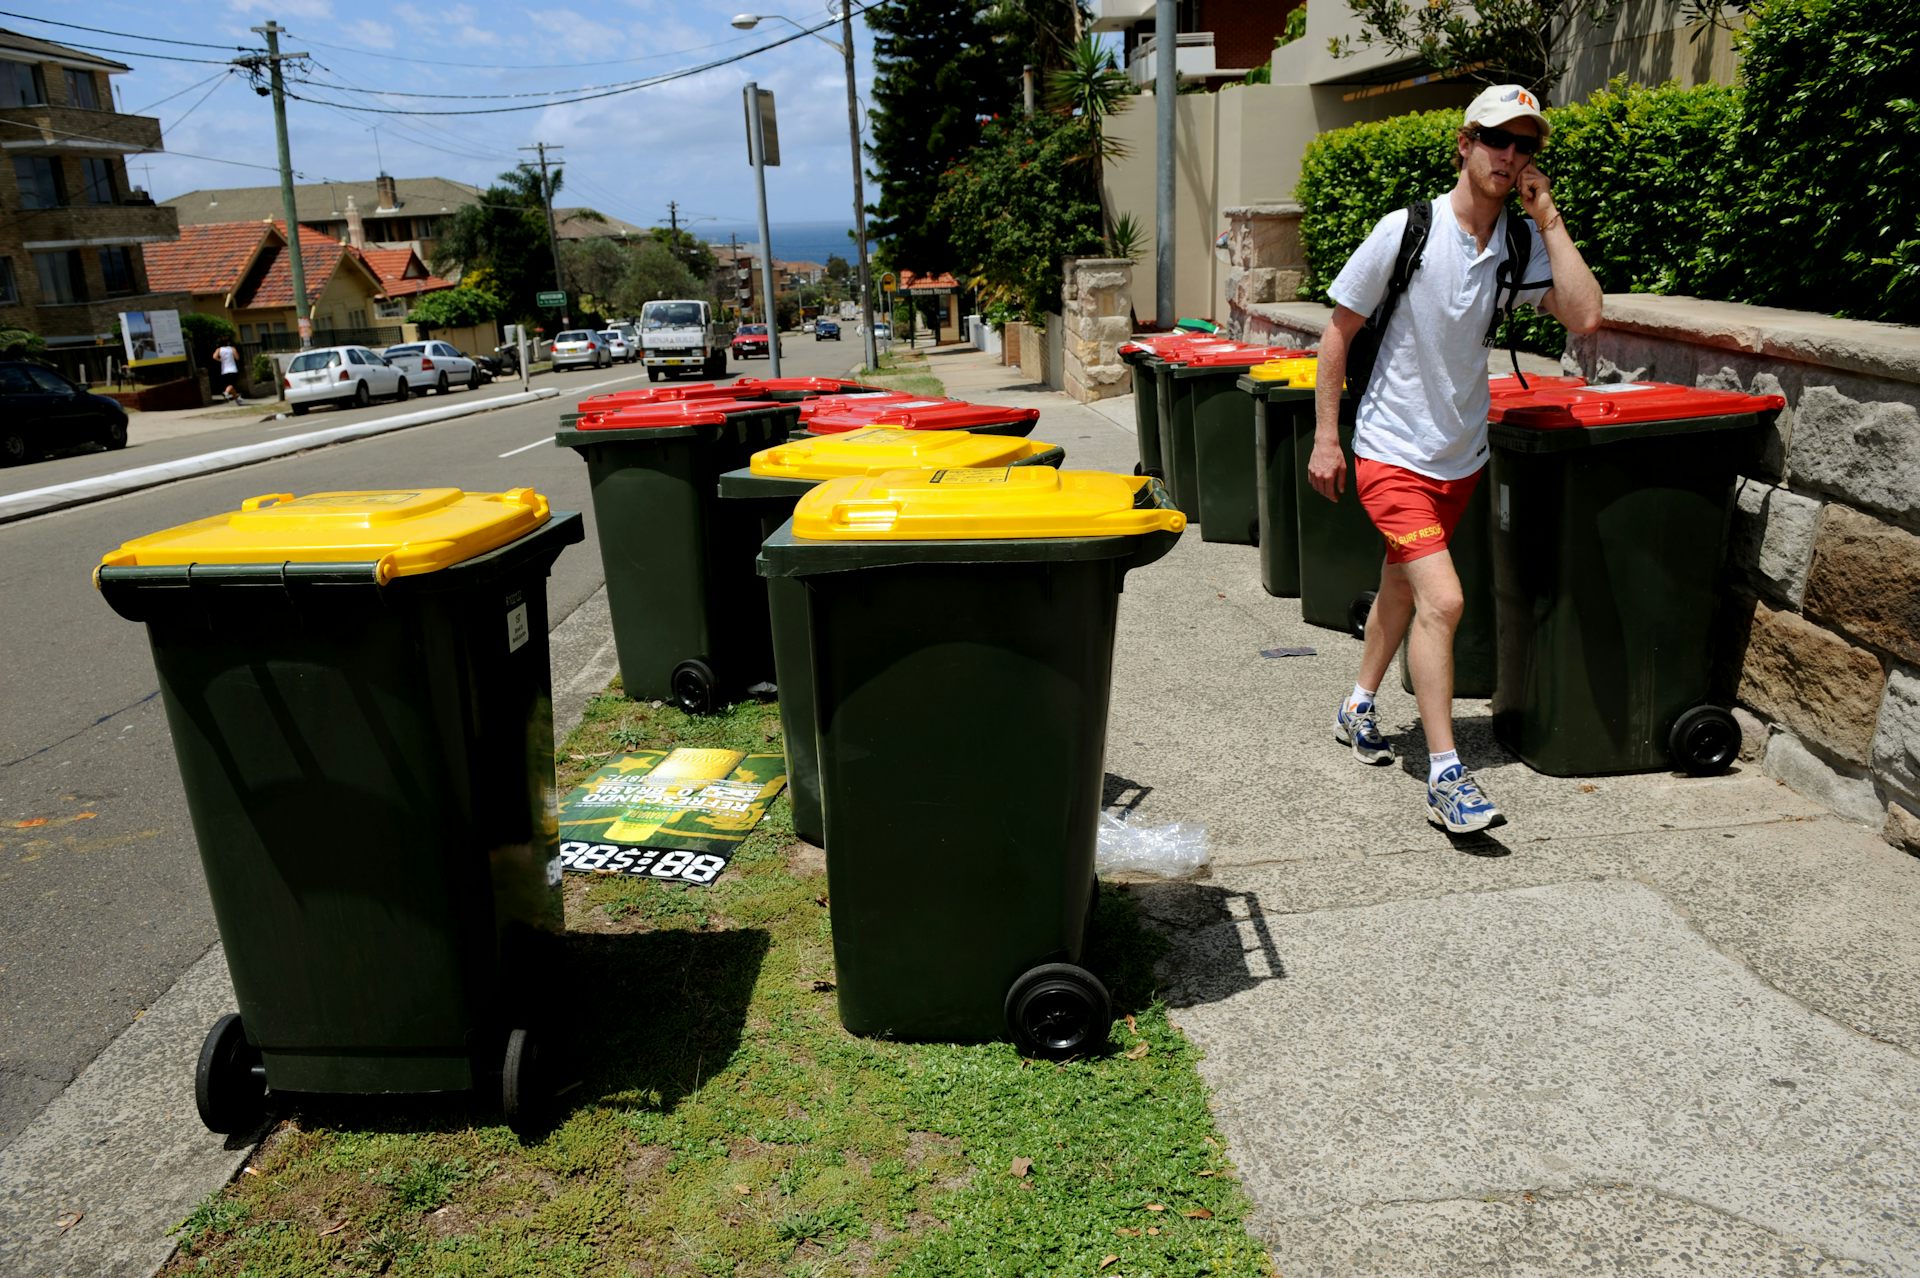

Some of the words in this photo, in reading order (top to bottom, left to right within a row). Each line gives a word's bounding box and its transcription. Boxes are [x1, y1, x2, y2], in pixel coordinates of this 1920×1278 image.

[1399, 531, 1417, 544] SURF
[596, 785, 667, 796] BRASIL
[677, 788, 694, 797] O
[582, 793, 751, 812] REFRESCANDO
[650, 851, 726, 883] 88
